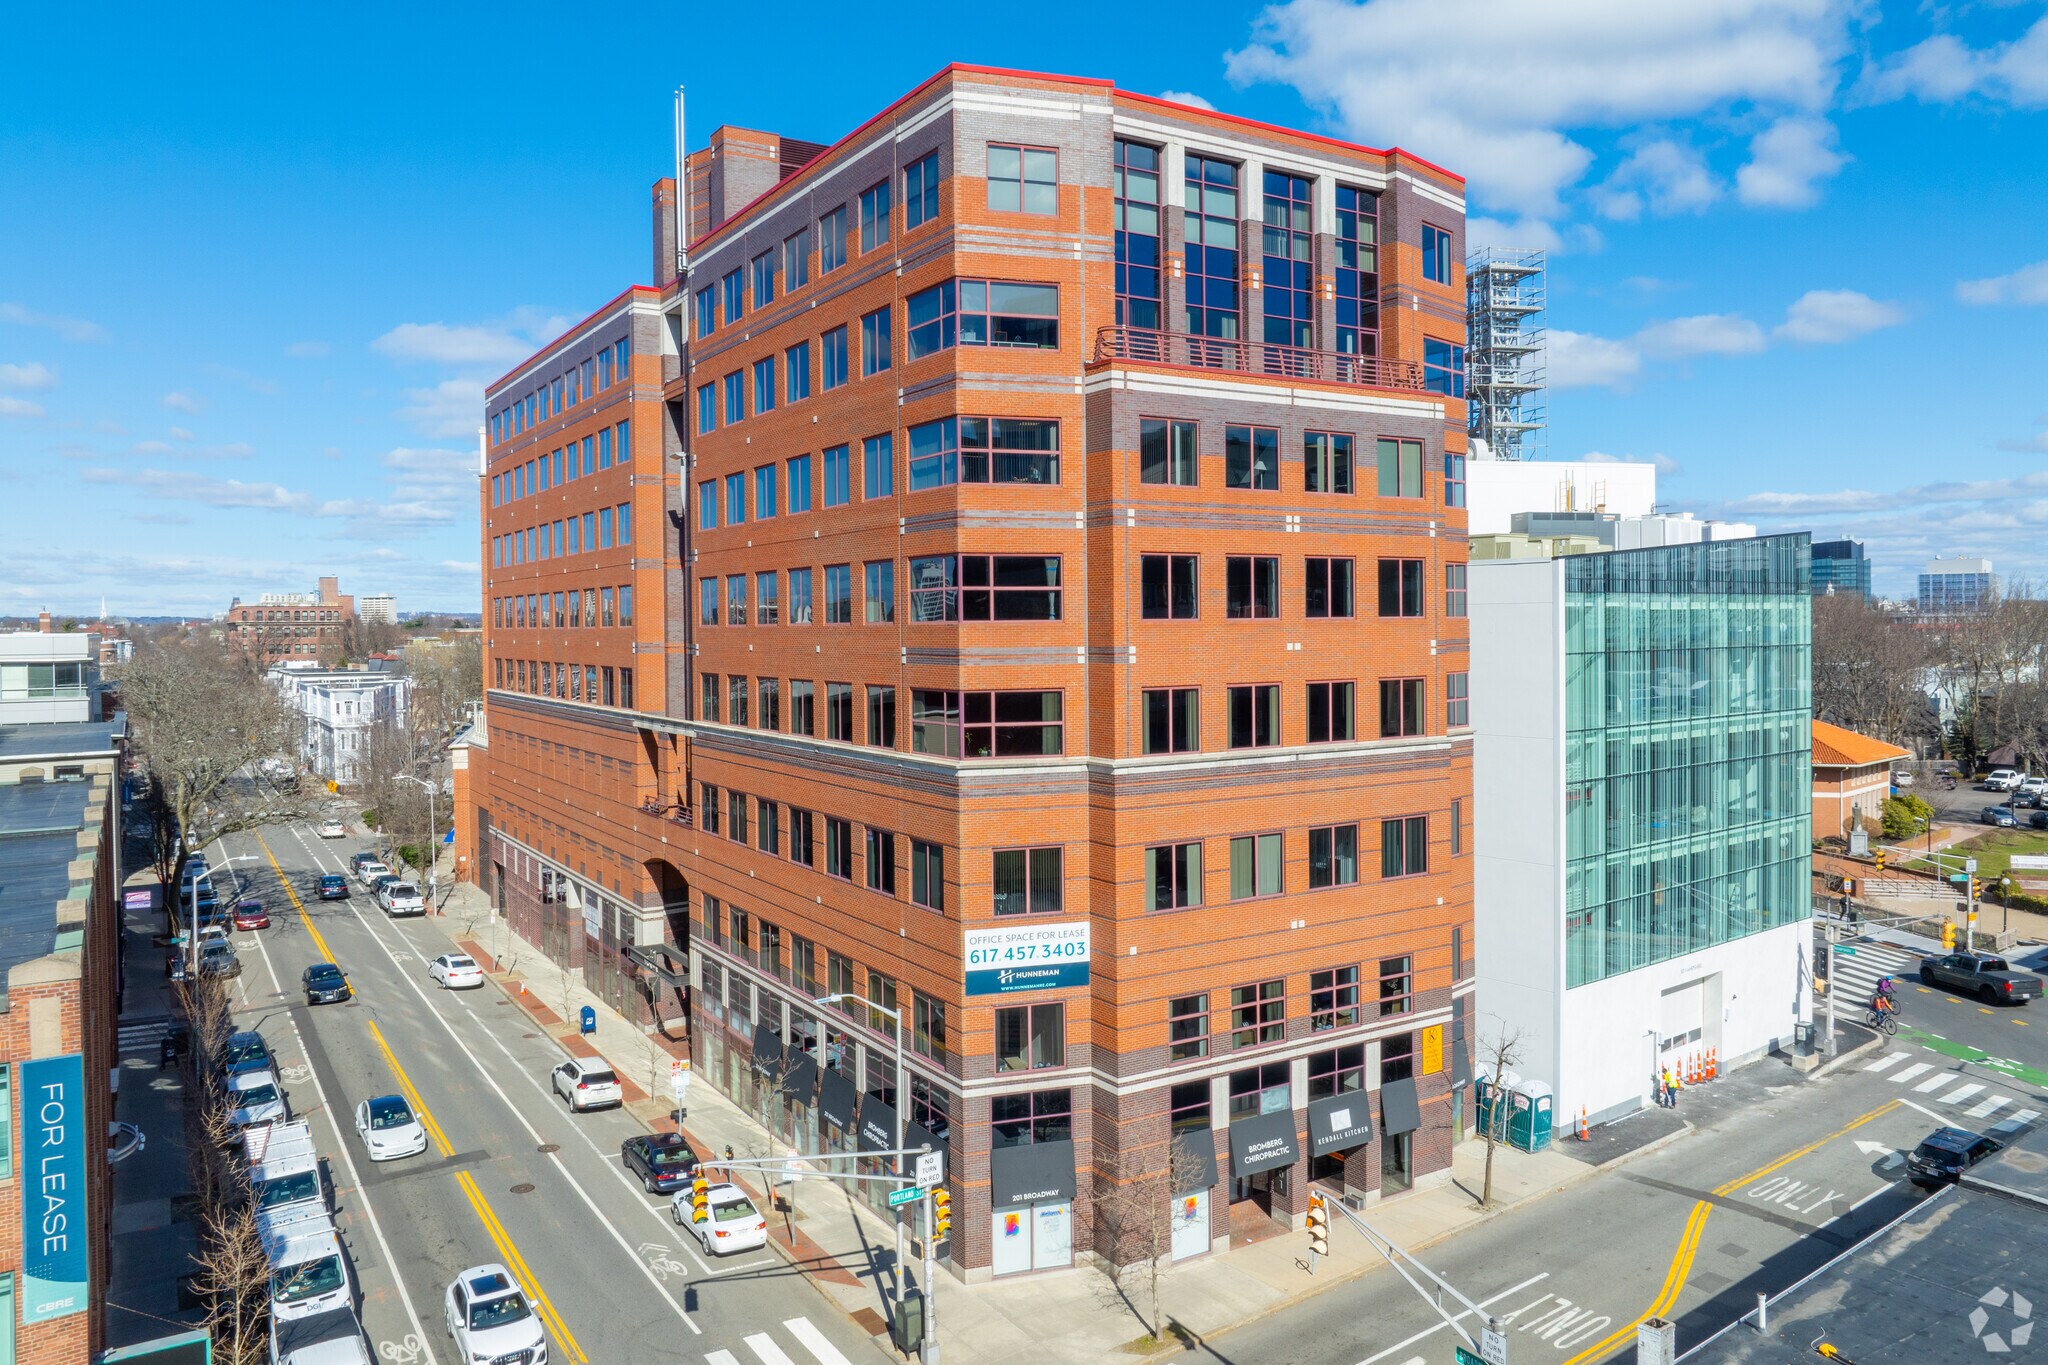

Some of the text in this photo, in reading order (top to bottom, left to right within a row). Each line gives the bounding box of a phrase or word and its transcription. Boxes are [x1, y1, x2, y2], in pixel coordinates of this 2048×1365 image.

[969, 928, 1085, 945] OFFICE SPACE FOR LEASE
[970, 941, 1086, 964] 617.457.3403
[1016, 969, 1060, 979] HUNNEMAN
[867, 1121, 888, 1140] BROMBERG
[1318, 1125, 1369, 1146] KENDALL KITCHEN
[1248, 1138, 1283, 1153] BROMBERG
[924, 1157, 934, 1165] NO
[1244, 1146, 1290, 1164] CHIROPRACTIC
[41, 1083, 67, 1256] FOR LEASE
[922, 1165, 937, 1174] TURN
[928, 1173, 940, 1181] RED
[890, 1190, 914, 1203] PORTLAND
[1012, 1189, 1060, 1202] 201 BROADWAY
[1747, 1176, 1845, 1214] ONLY
[36, 1297, 74, 1314] CBRE
[1502, 1292, 1611, 1349] ONLY
[1488, 1334, 1499, 1344] NO
[1483, 1348, 1505, 1365] ON RED
[1486, 1341, 1502, 1355] TURN
